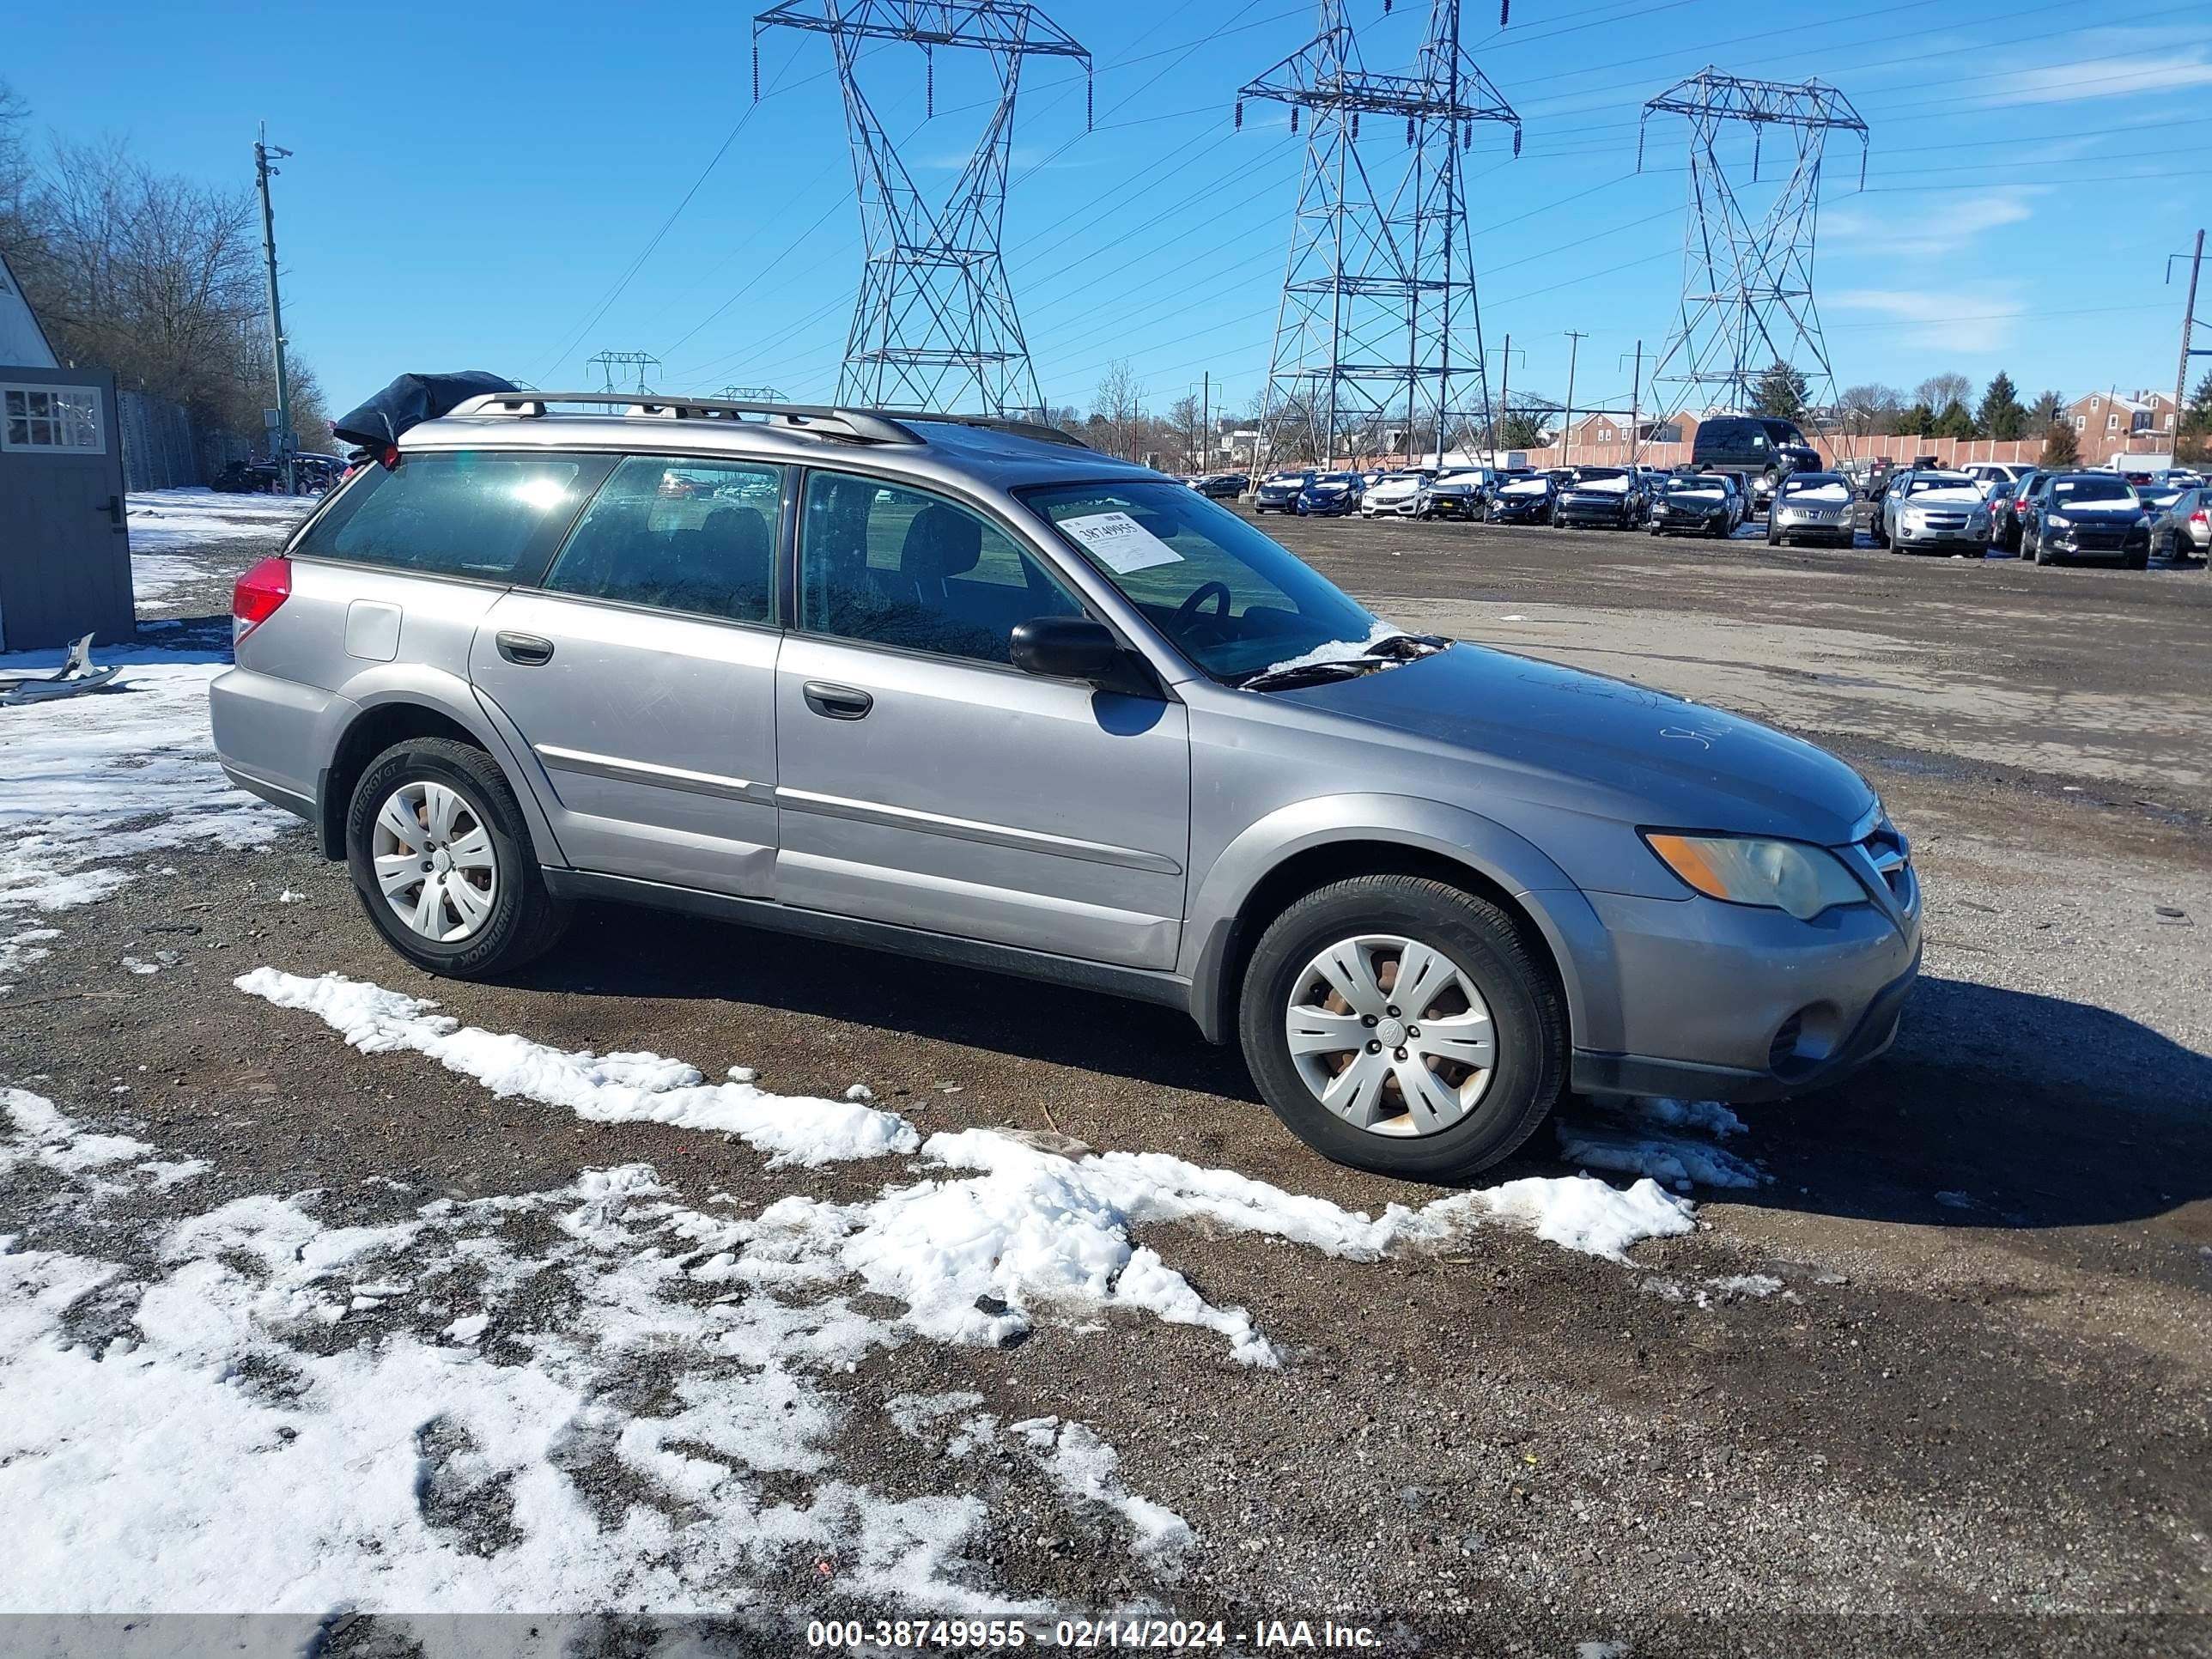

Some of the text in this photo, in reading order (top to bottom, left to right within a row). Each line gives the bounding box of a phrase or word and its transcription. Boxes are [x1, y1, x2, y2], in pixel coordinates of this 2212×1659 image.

[1079, 523, 1138, 541] 38749955
[351, 762, 398, 835] KINERGY GT
